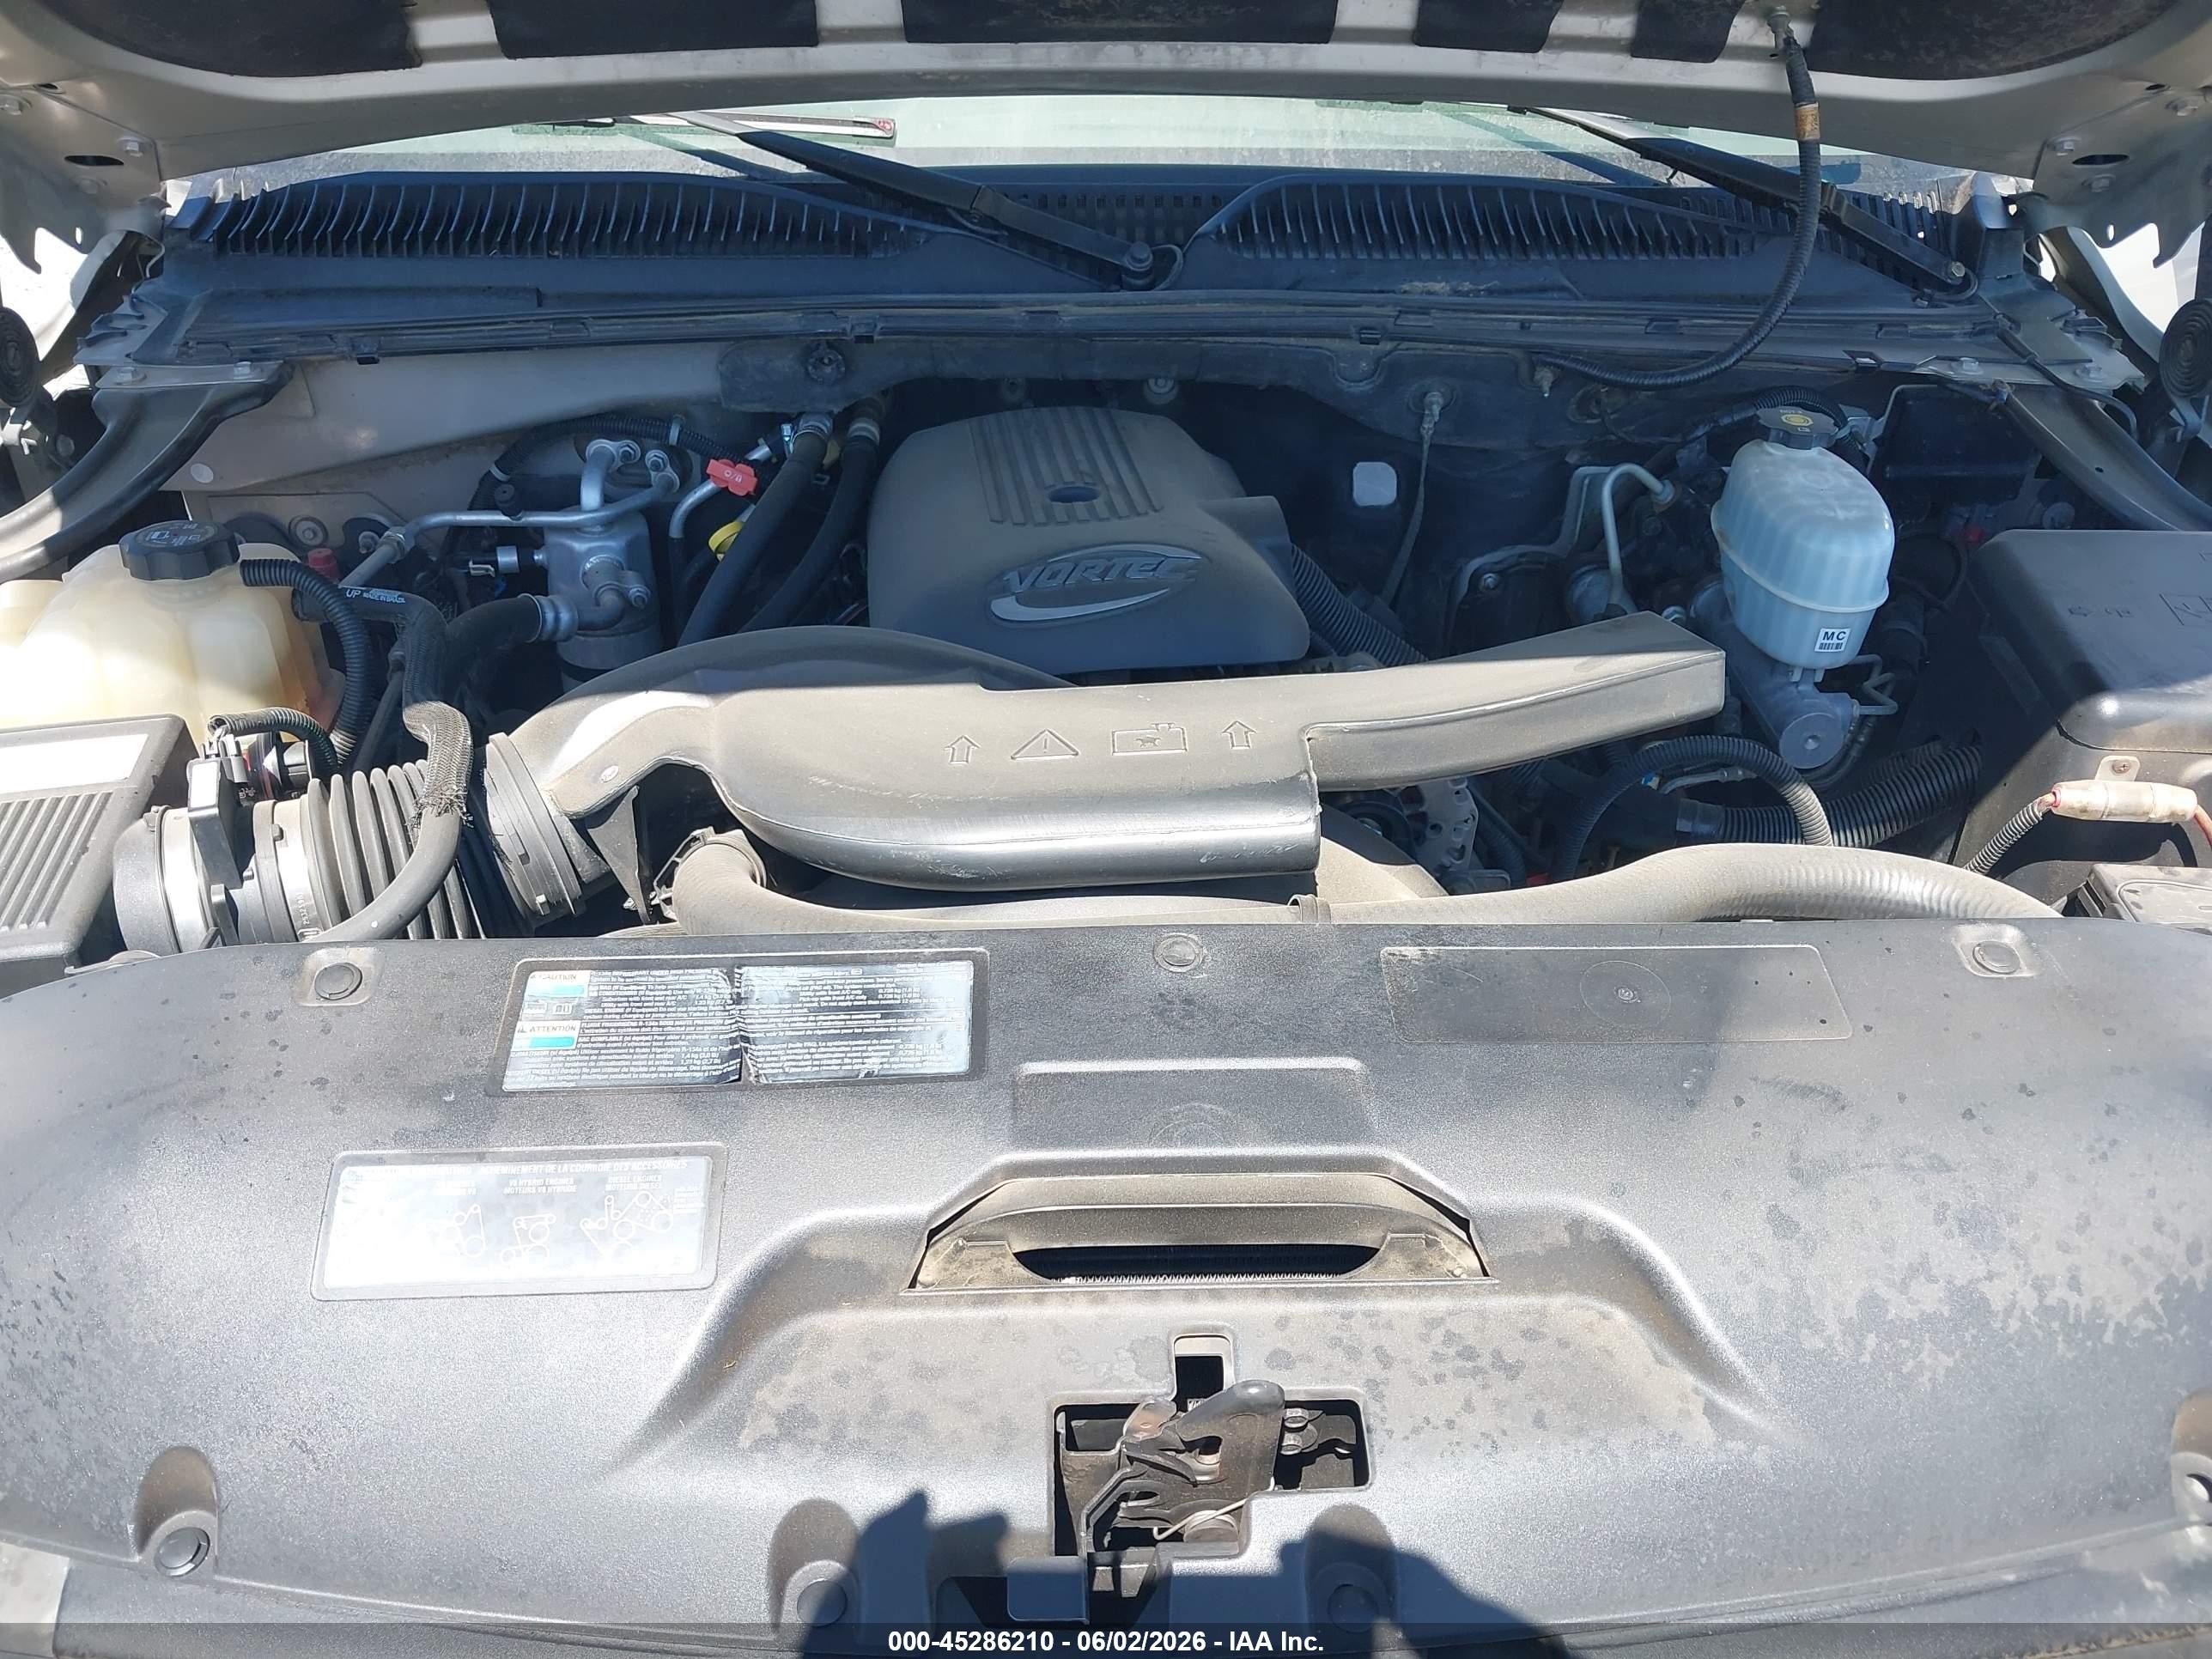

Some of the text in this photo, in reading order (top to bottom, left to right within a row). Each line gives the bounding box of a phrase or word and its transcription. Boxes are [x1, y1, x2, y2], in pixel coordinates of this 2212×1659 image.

[1002, 556, 1201, 594] VORTEC
[345, 589, 361, 598] UP
[1822, 631, 1846, 641] MC
[529, 1024, 576, 1033] ATTENTION
